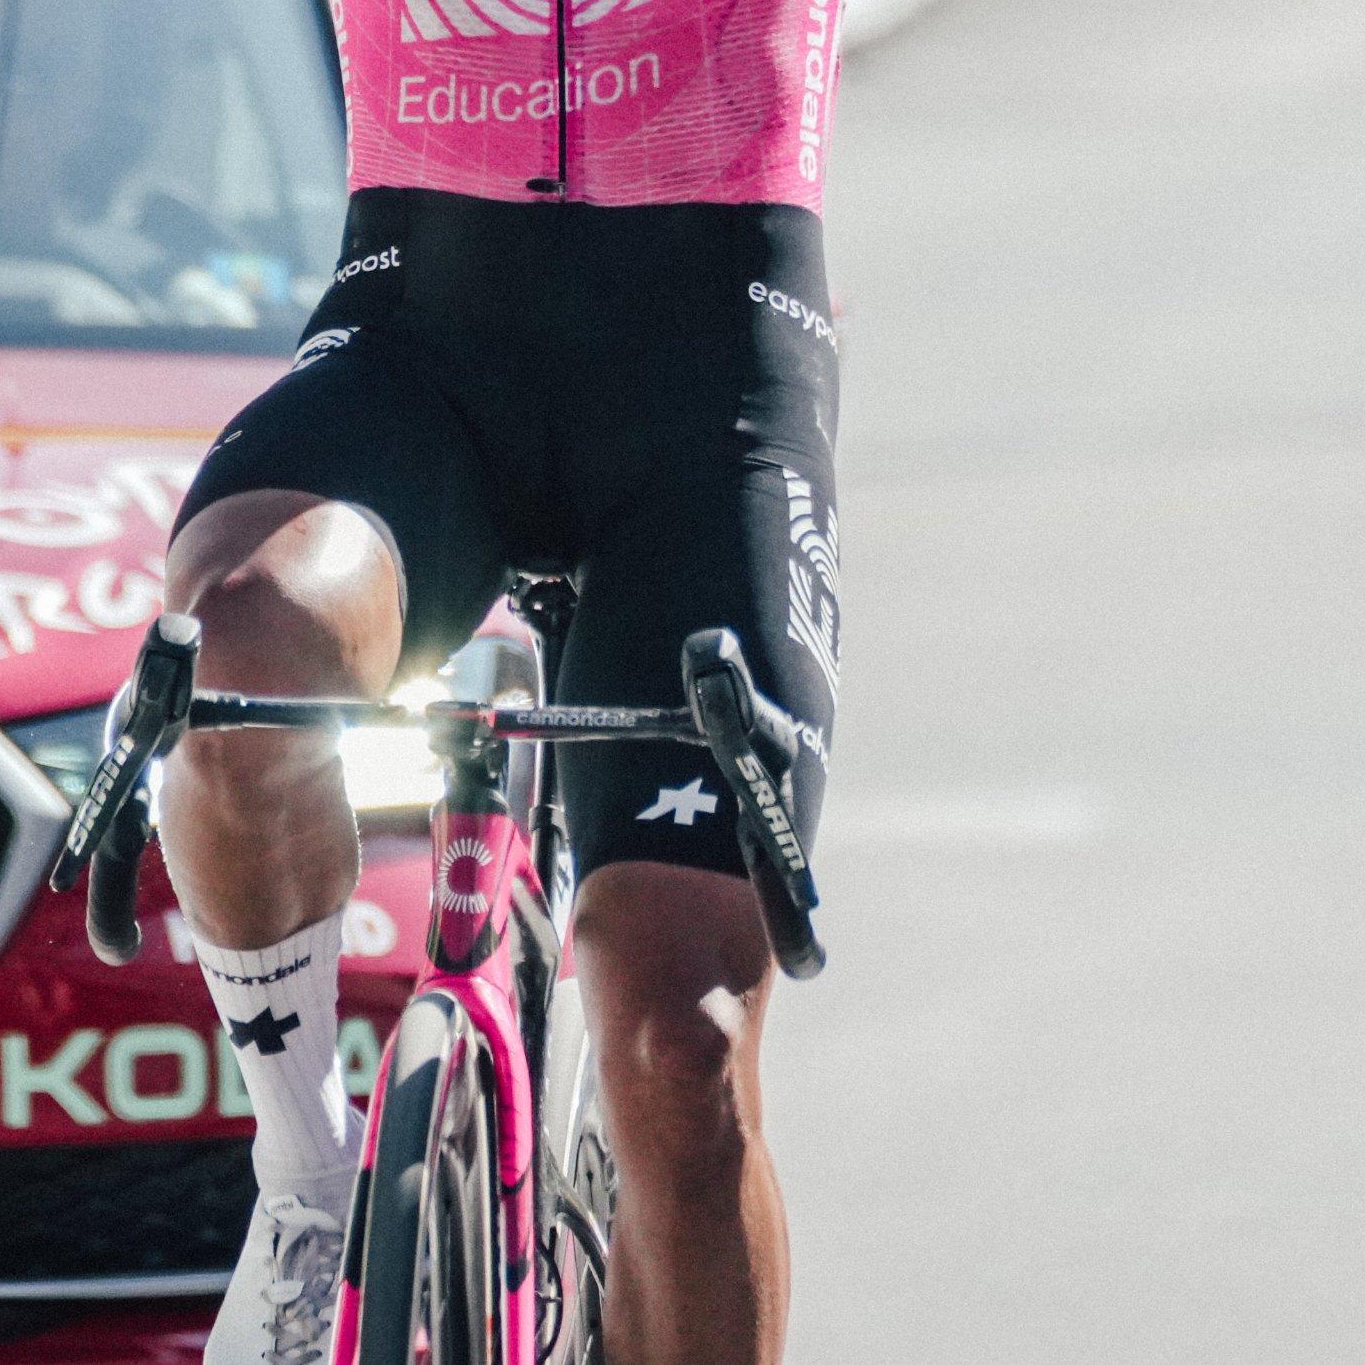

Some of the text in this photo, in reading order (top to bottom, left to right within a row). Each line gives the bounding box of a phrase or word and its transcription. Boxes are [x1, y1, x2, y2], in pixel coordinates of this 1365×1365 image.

[397, 51, 661, 125] Education
[748, 281, 837, 354] easypo
[67, 735, 135, 856] SRAM
[735, 754, 806, 872] SRAM
